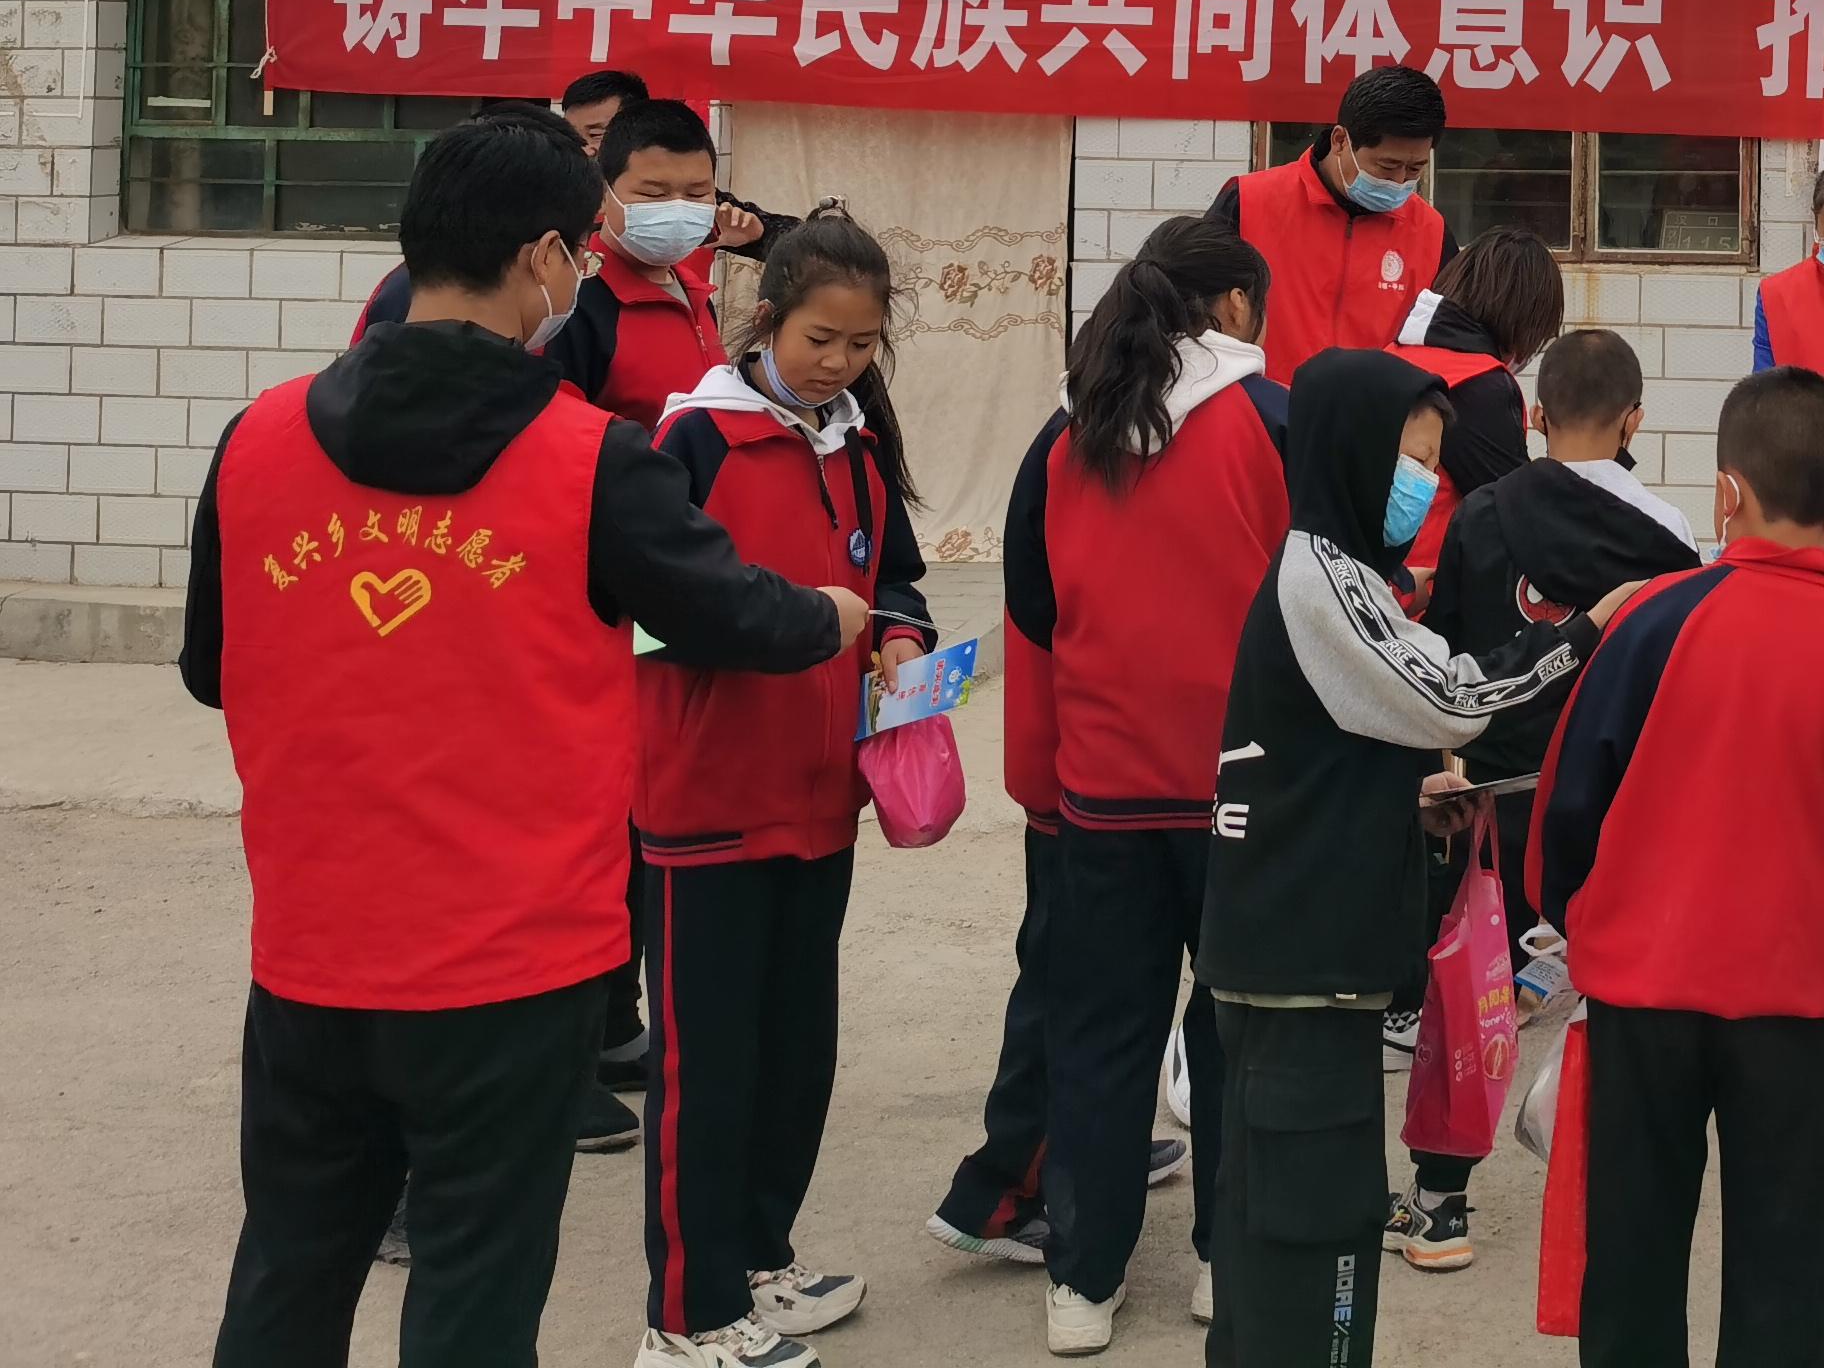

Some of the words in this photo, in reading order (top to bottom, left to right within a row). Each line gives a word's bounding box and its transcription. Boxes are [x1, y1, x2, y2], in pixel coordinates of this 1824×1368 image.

[1332, 558, 1355, 589] ERKE
[1537, 650, 1573, 682] ERKE
[1454, 694, 1480, 709] ERK
